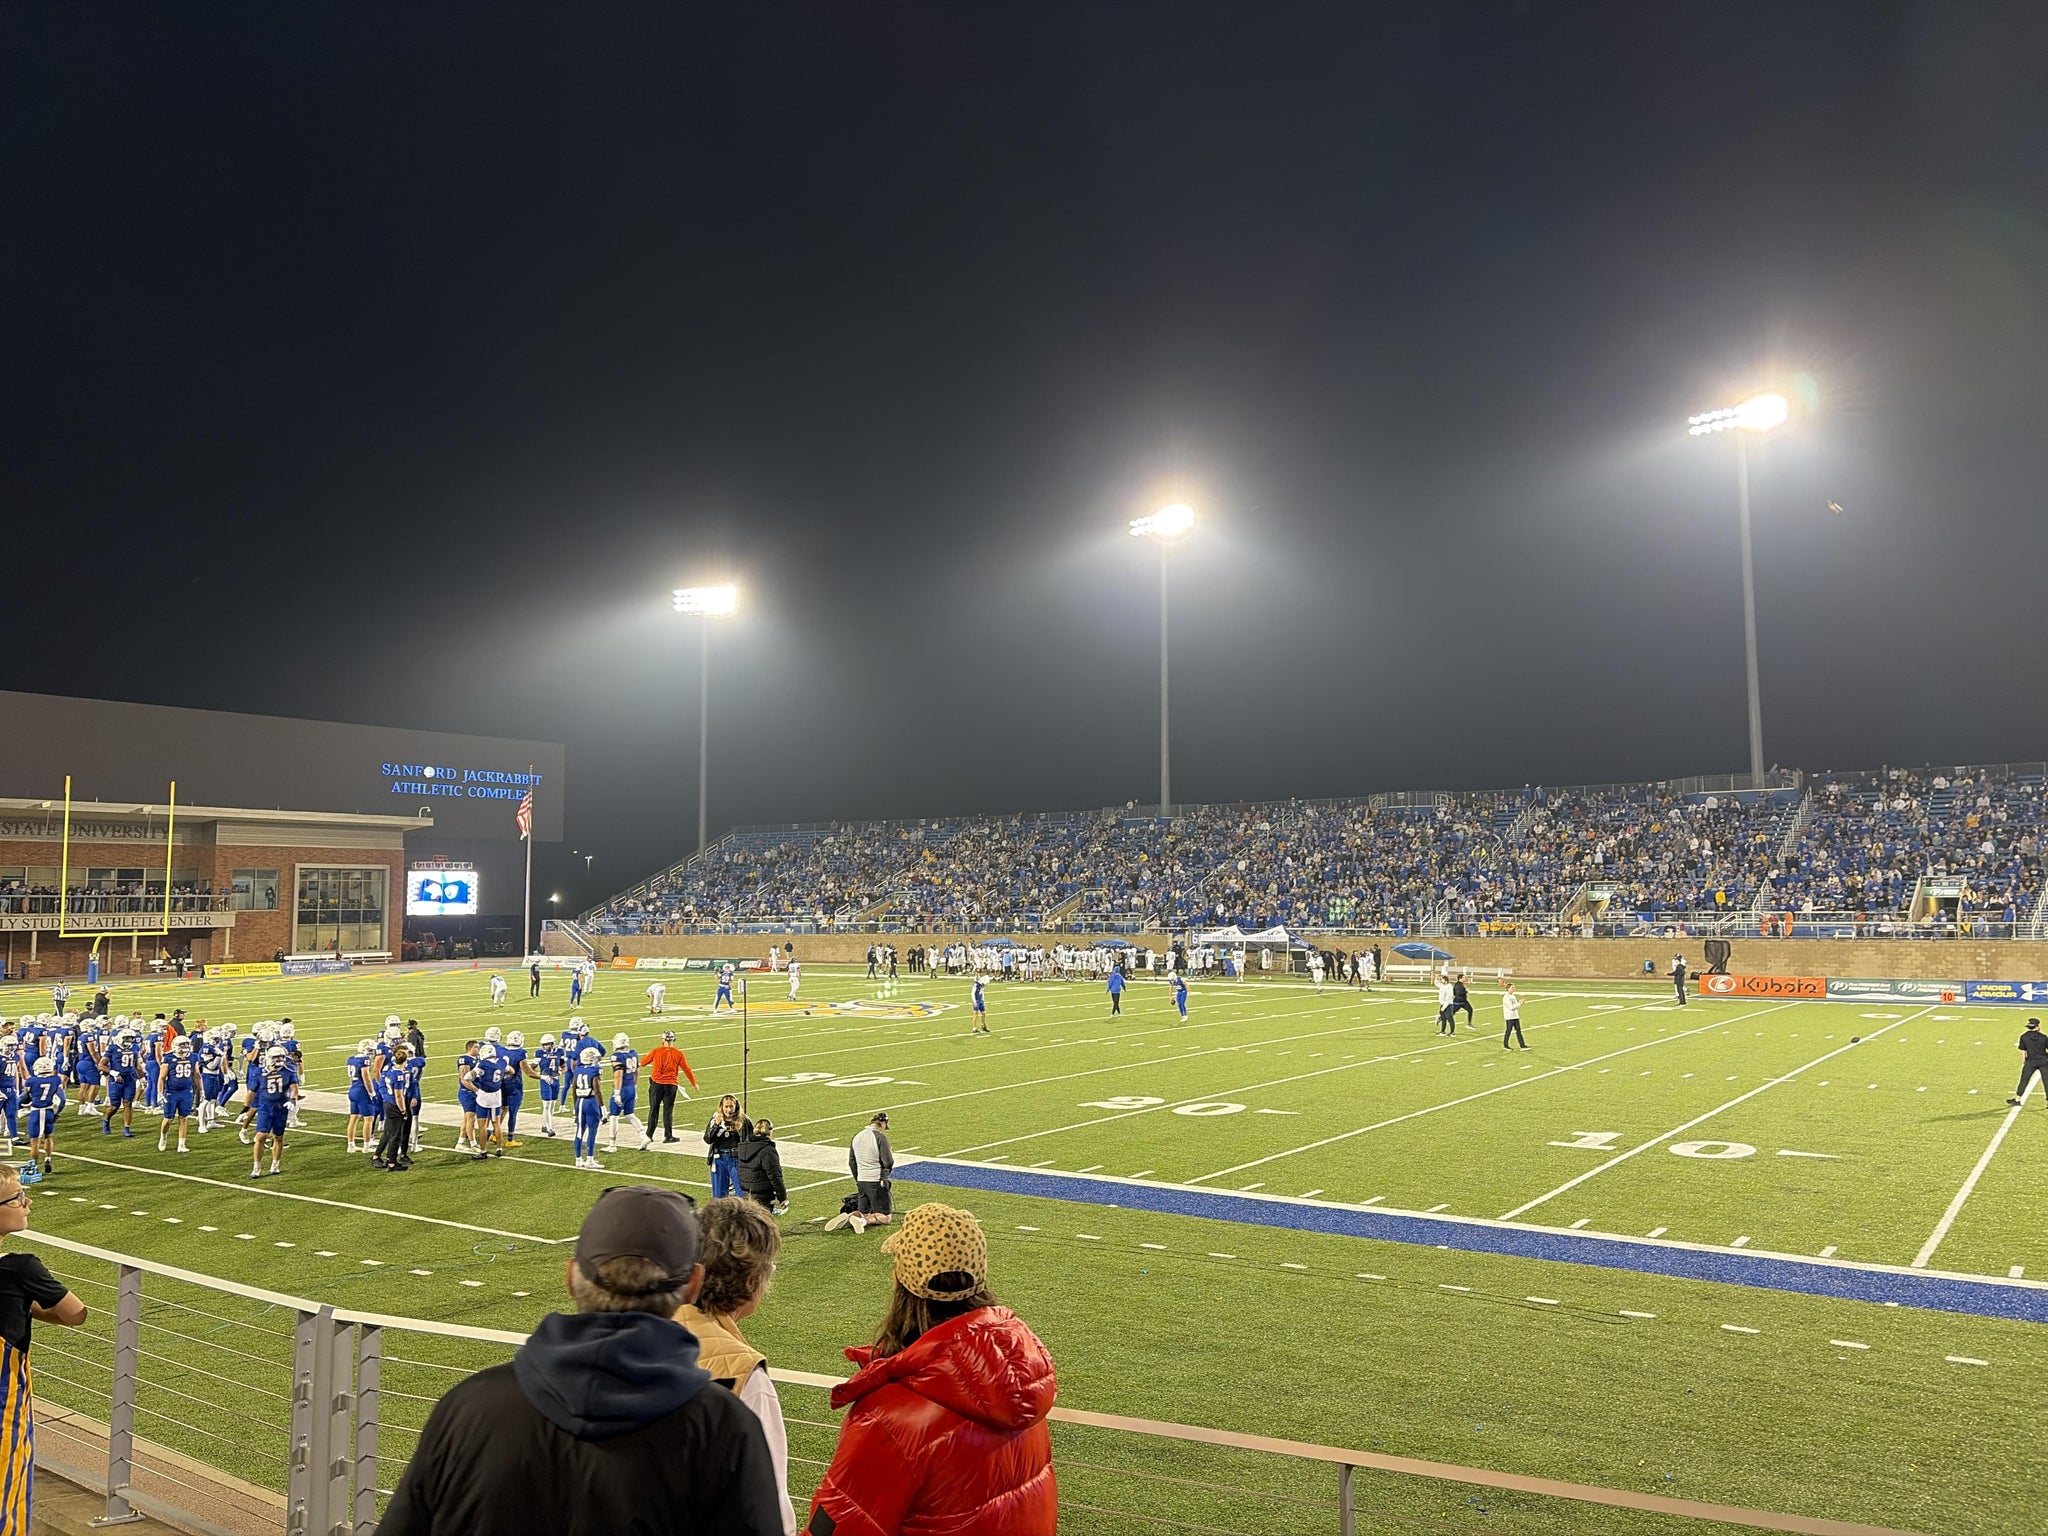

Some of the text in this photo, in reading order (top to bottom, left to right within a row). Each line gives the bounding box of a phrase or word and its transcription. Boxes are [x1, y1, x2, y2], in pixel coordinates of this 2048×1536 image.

[391, 782, 463, 797] ATHLETIC
[1, 820, 57, 836] STATE
[22, 916, 157, 929] STUDENT-ATHLETE
[1742, 978, 1817, 994] Kubota
[1943, 993, 1953, 1001] 10
[121, 1054, 134, 1067] 91
[549, 1058, 556, 1072] 4
[175, 1063, 191, 1078] 96
[493, 1069, 501, 1082] 6
[267, 1078, 283, 1094] 51
[576, 1074, 589, 1089] 41
[40, 1083, 51, 1101] 7
